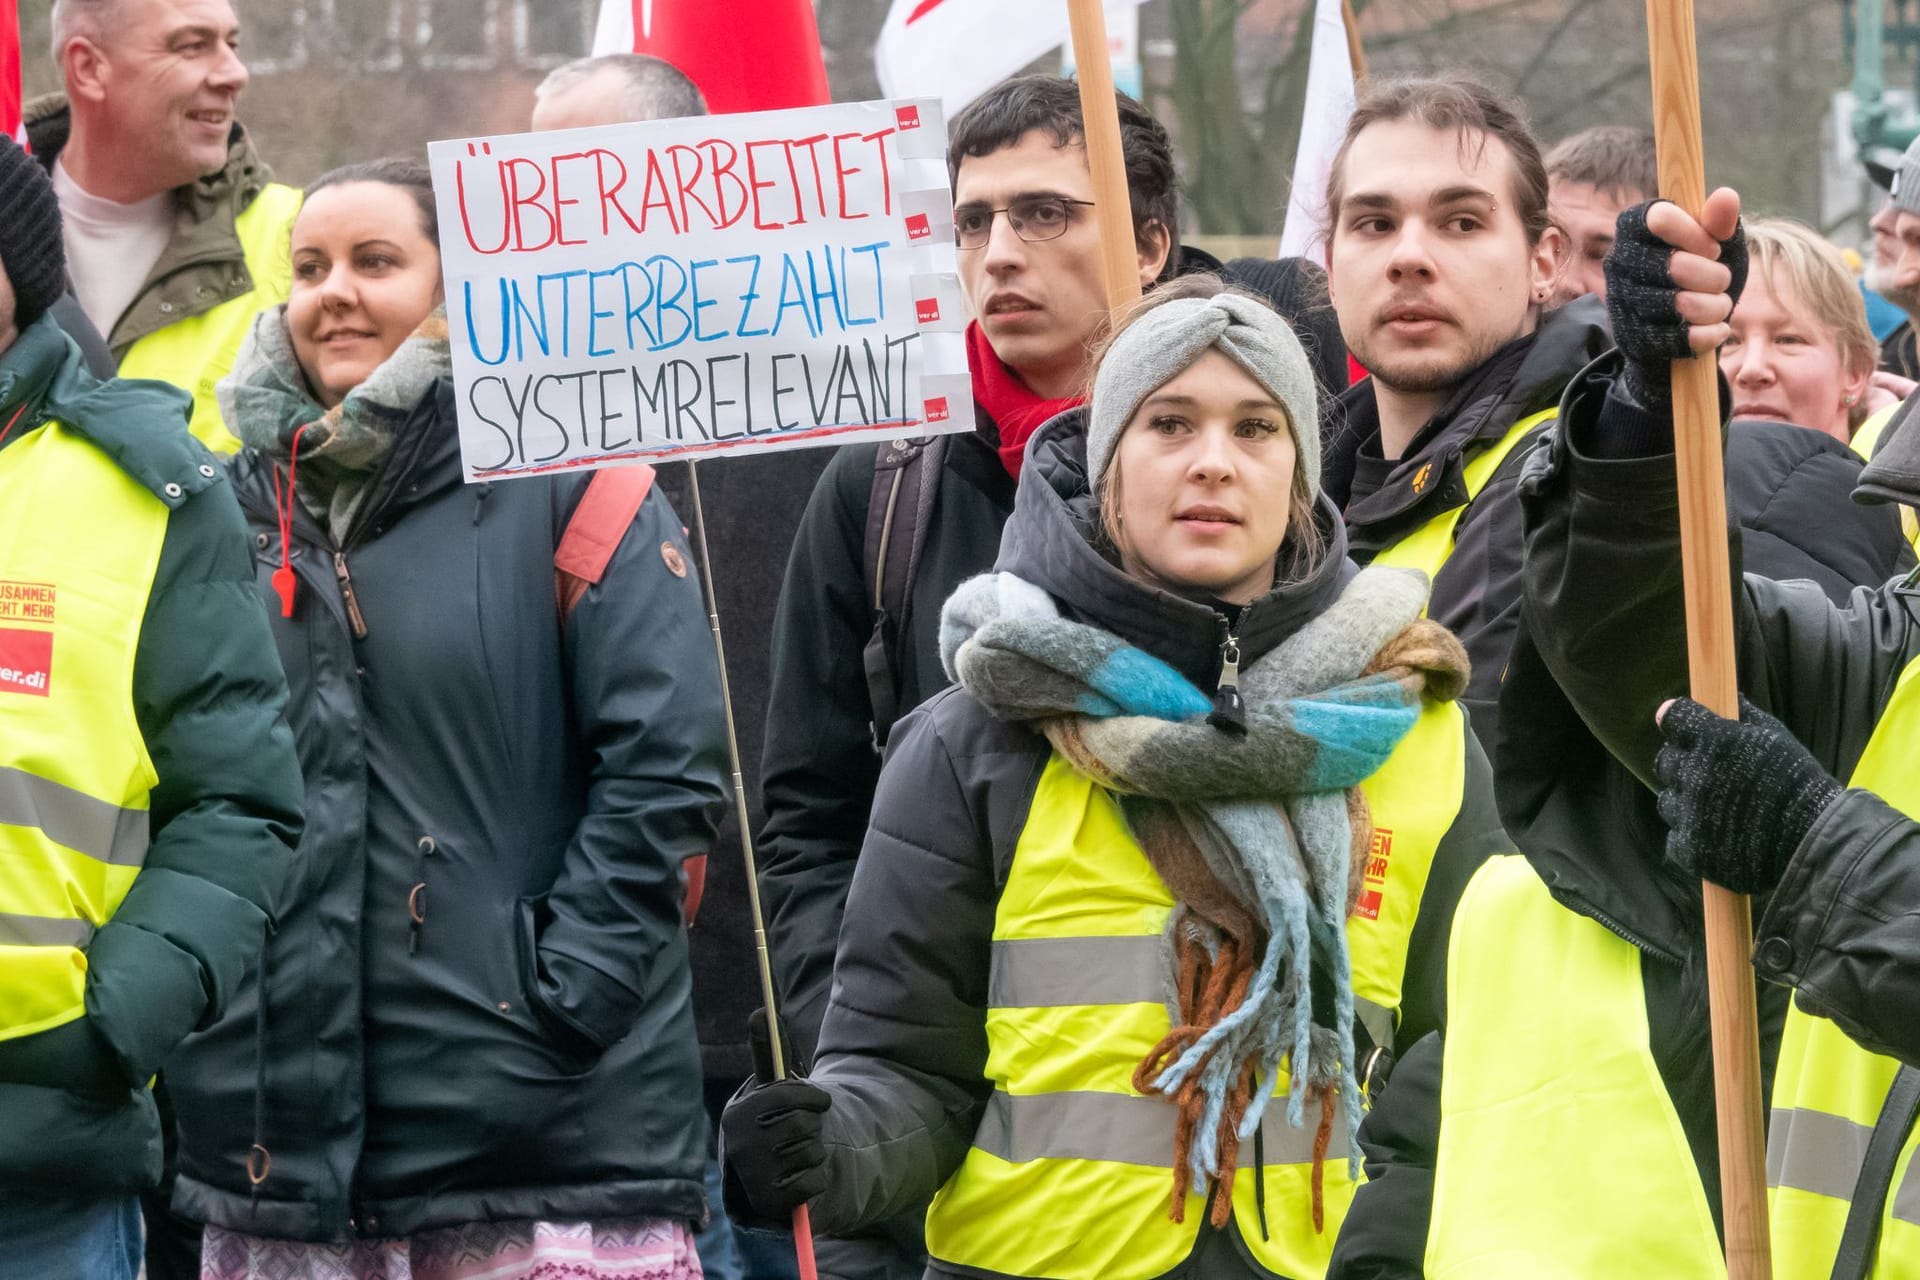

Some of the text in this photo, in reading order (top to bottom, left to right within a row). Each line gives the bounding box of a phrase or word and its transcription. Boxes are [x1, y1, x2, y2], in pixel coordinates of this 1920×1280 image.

[456, 127, 896, 254] ÜBERARBEITET
[464, 240, 890, 366] UNTERBEZAHLT
[469, 332, 921, 472] SYSTEMRELEVANT
[22, 602, 55, 619] MEHR
